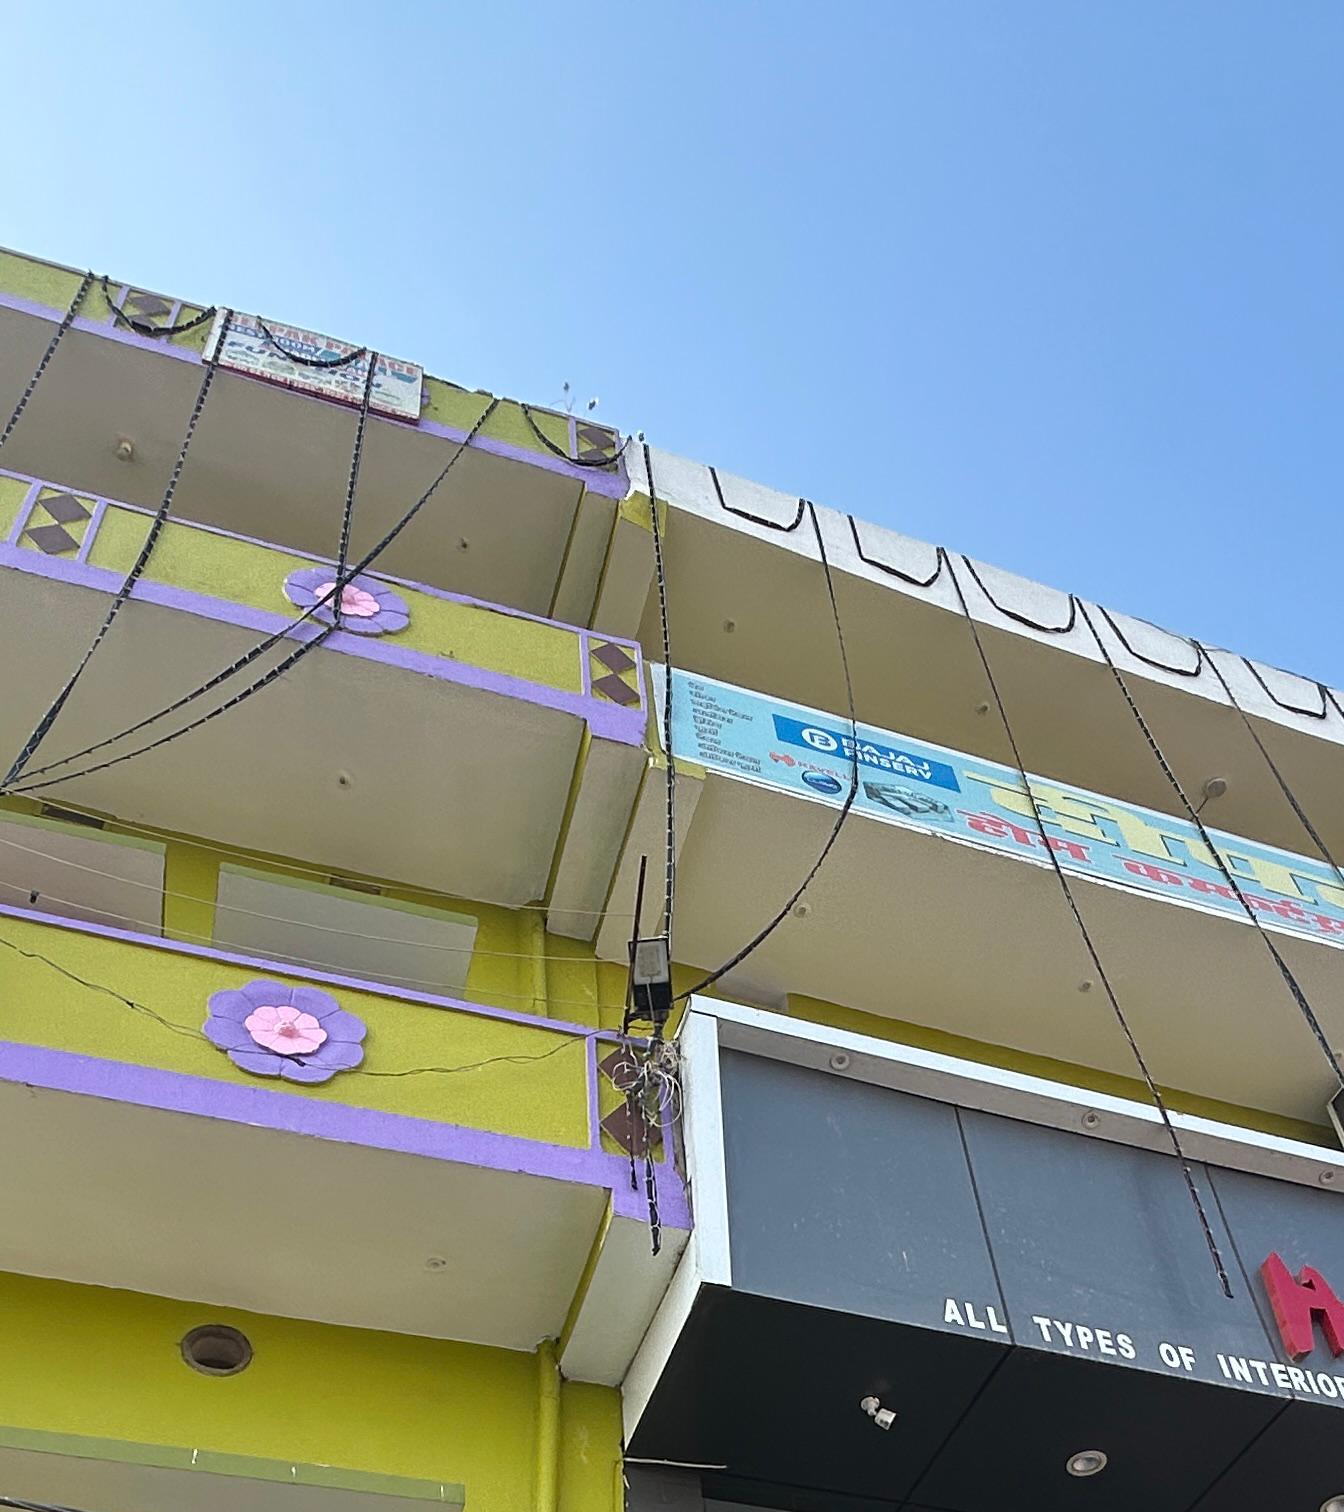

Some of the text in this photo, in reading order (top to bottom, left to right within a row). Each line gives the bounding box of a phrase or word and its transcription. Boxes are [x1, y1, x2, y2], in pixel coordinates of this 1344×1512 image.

[841, 736, 931, 771] BAJAJ
[844, 748, 933, 780] FINSERV
[956, 809, 1092, 864] होम
[944, 1298, 1008, 1334] ALL
[1032, 1315, 1137, 1359] TYPES
[1158, 1342, 1197, 1371] OF
